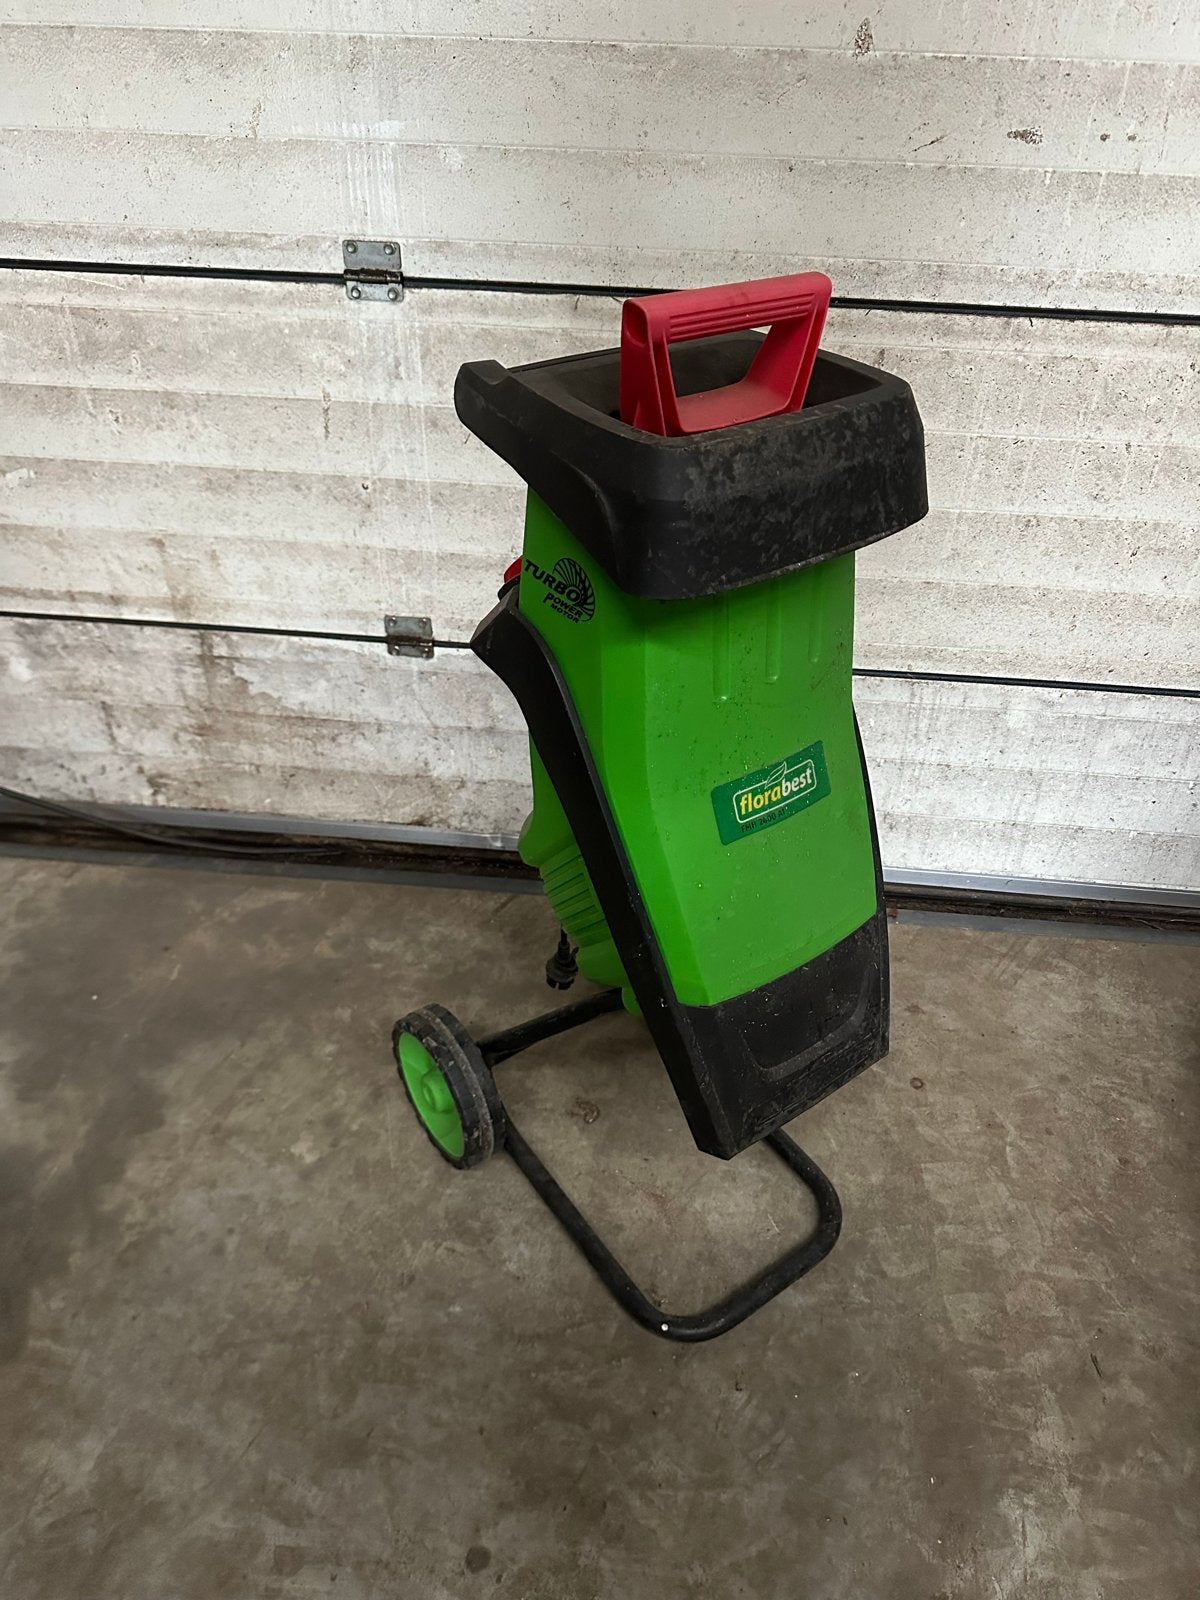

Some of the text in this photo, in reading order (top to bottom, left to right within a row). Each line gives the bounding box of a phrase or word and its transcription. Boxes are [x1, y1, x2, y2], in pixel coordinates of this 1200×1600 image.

[525, 559, 580, 603] TURBO
[543, 592, 583, 618] POWER
[550, 603, 580, 623] MOTOR
[740, 767, 812, 815] florabest
